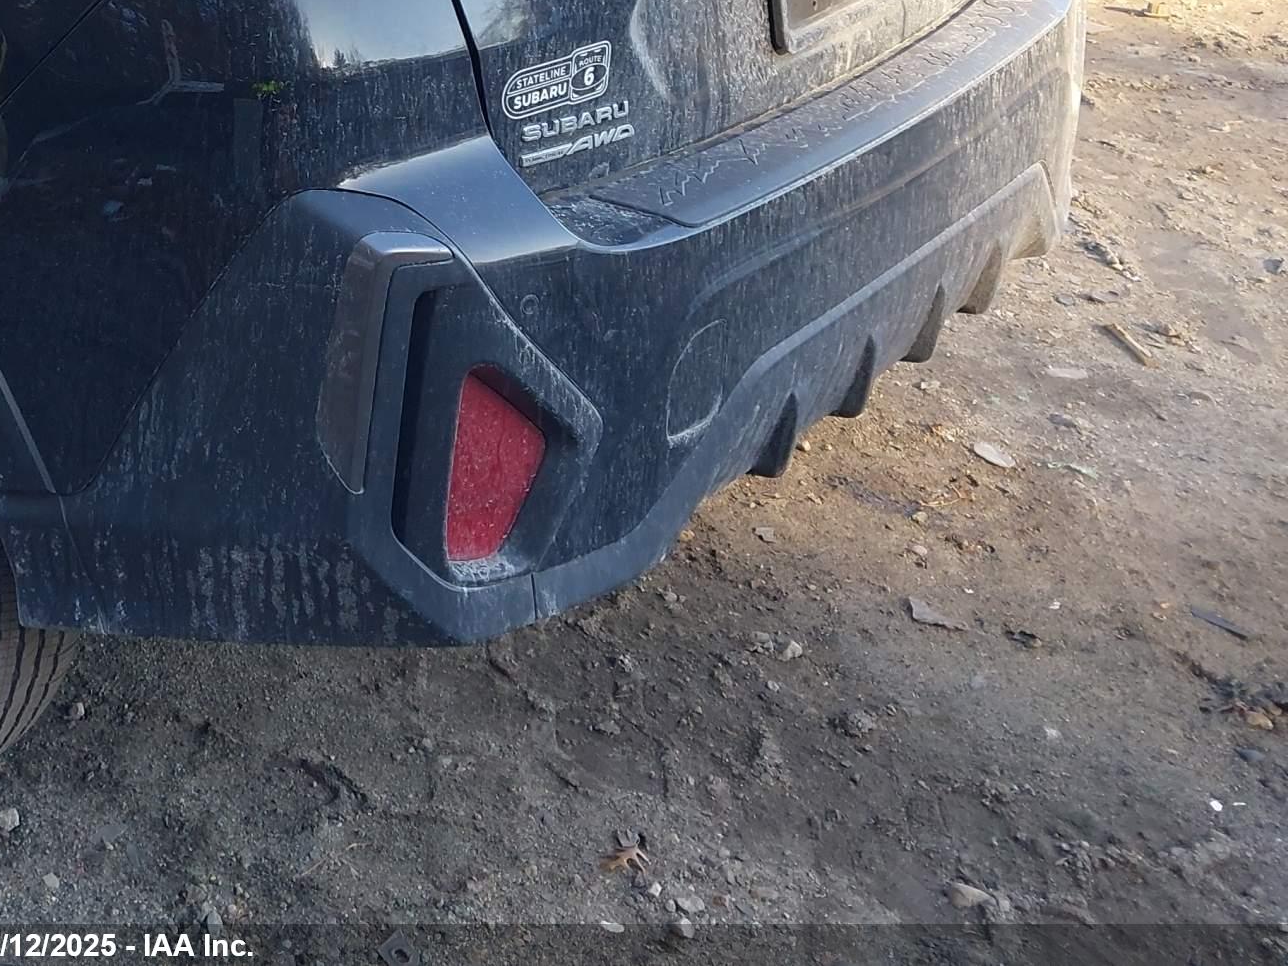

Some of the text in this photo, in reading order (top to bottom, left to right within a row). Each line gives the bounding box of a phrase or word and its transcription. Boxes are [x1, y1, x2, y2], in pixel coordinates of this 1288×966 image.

[579, 55, 603, 67] ROUTE
[516, 65, 567, 89] STATELINE
[583, 66, 595, 86] 6
[513, 83, 568, 110] SUBARU
[521, 100, 629, 142] SUBARU
[566, 123, 636, 156] AWD
